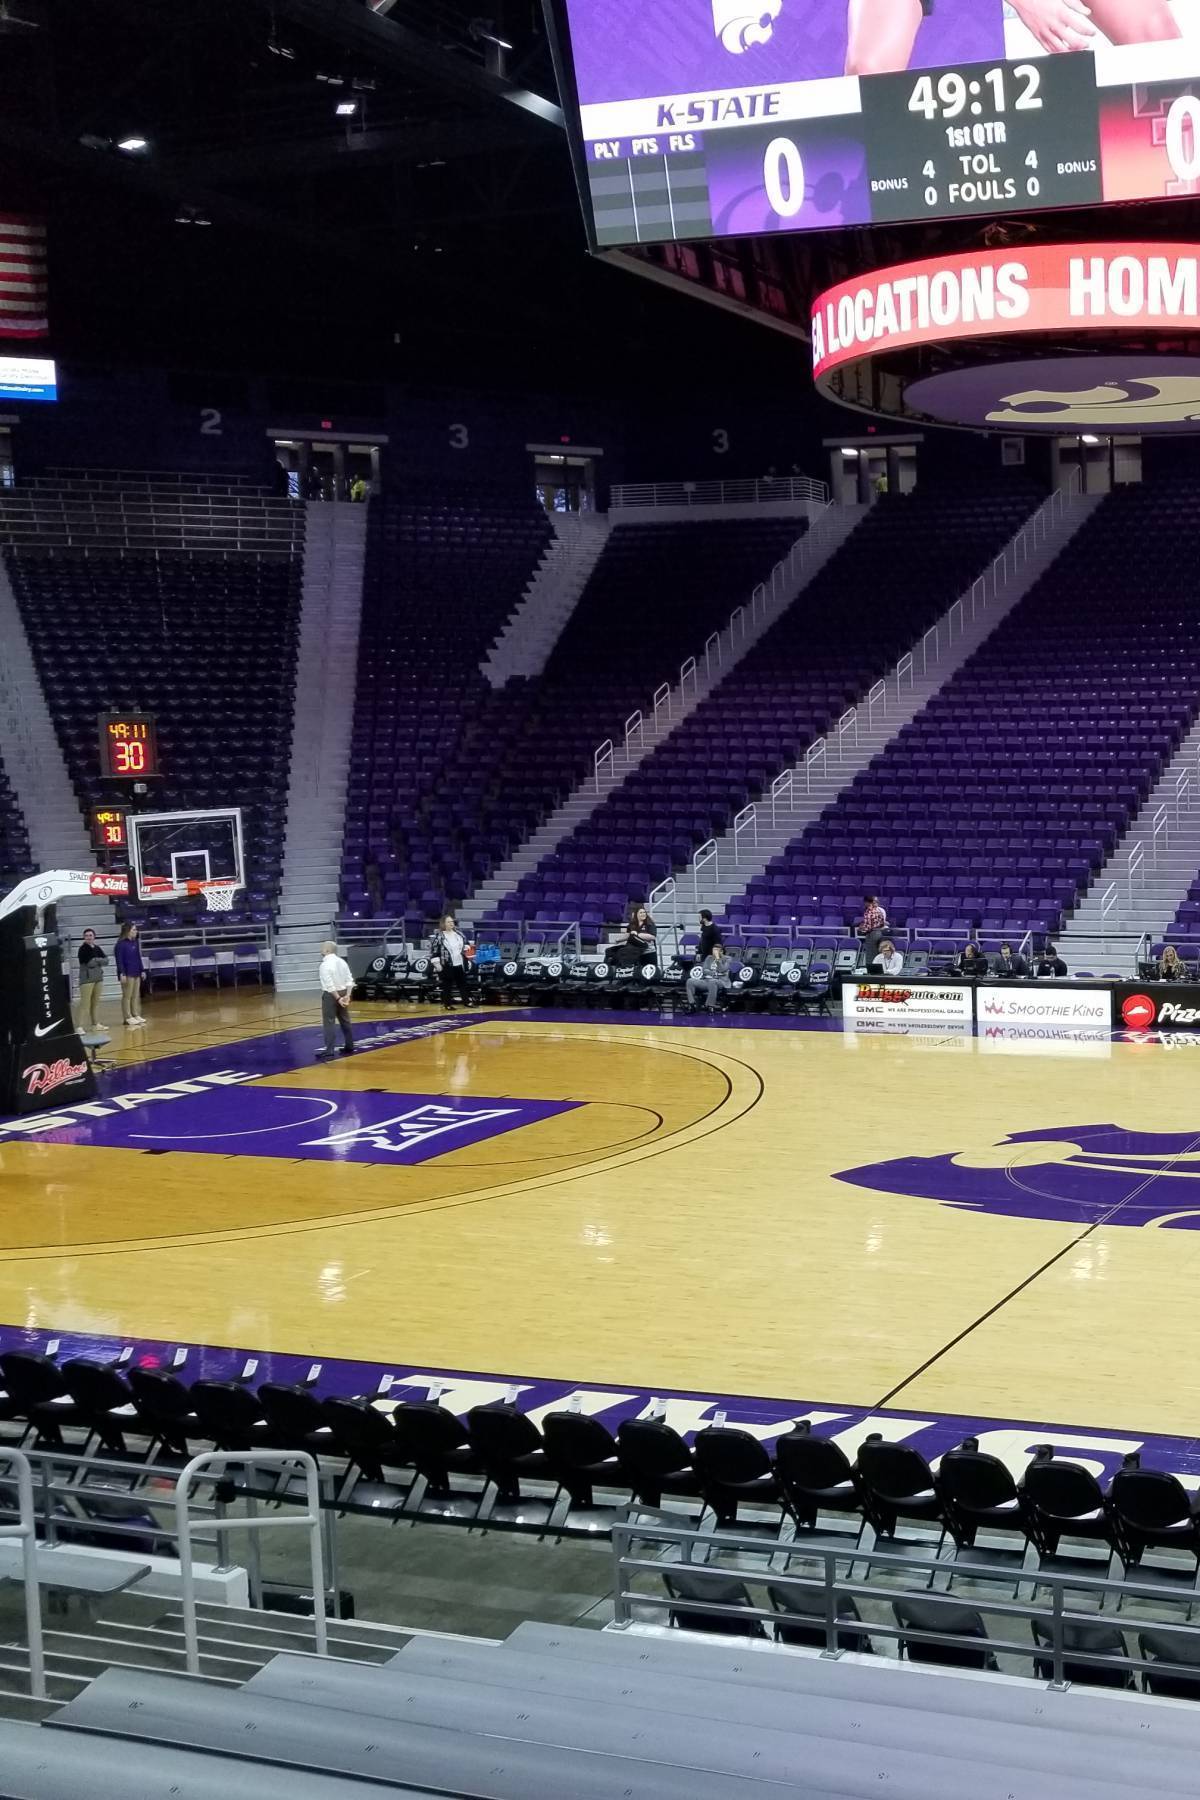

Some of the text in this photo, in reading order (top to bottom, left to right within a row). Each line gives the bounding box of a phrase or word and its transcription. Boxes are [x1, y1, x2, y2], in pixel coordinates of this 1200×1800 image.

[908, 64, 1043, 119] 49:12
[656, 91, 781, 127] K-STATE
[594, 133, 696, 160] PLY PTS FLS
[946, 121, 1007, 147] 1st QTR
[763, 137, 804, 217] 0
[922, 149, 1038, 179] 4 TOL 4
[1057, 159, 1097, 175] BONUS
[871, 177, 909, 192] BONUS
[924, 176, 1040, 206] 0 FOULS 0
[827, 262, 1030, 354] LOCATIONS
[200, 408, 223, 435] 2
[449, 423, 469, 449] 3
[712, 428, 730, 453] 3
[109, 723, 146, 738] 49:11
[116, 741, 144, 770] 30
[106, 826, 122, 843] 30
[104, 877, 128, 891] State
[40, 950, 52, 1018] WILDCATS
[855, 1006, 885, 1014] GMC
